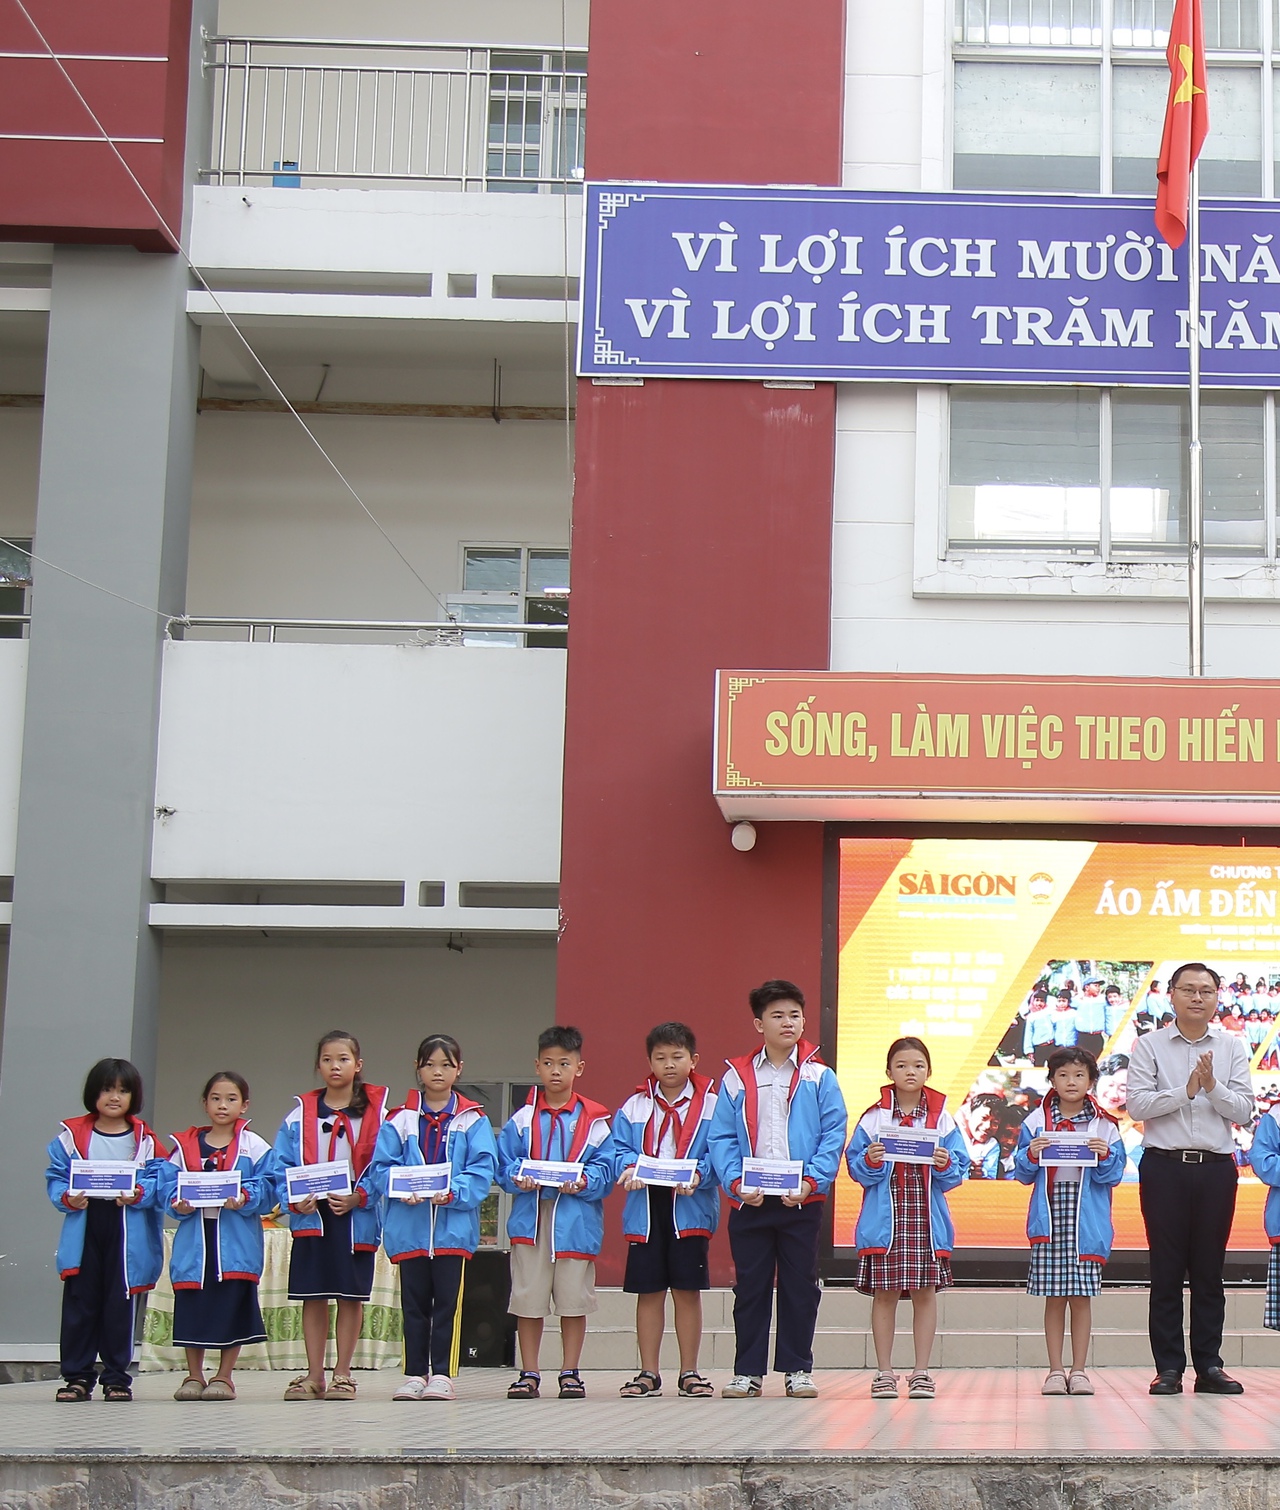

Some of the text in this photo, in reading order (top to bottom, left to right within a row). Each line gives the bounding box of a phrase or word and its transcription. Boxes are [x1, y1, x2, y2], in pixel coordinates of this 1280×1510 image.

[671, 221, 739, 273] VÌ
[759, 228, 864, 285] LỢI
[884, 224, 997, 279] ÍCH
[1017, 230, 1179, 282] MƯỜI
[624, 287, 691, 340] VÌ
[711, 293, 818, 352] LỢI
[836, 290, 952, 345] ÍCH
[971, 295, 1155, 349] TRĂM
[764, 695, 879, 764] SỐNG,
[889, 703, 971, 759] LÀM
[981, 705, 1065, 770] VIỆC
[1075, 715, 1167, 762] THEO
[1178, 703, 1265, 763] HIẾN
[1094, 879, 1143, 917] ÁO
[1148, 880, 1202, 917] ẤM
[1209, 881, 1277, 918] ĐẾN
